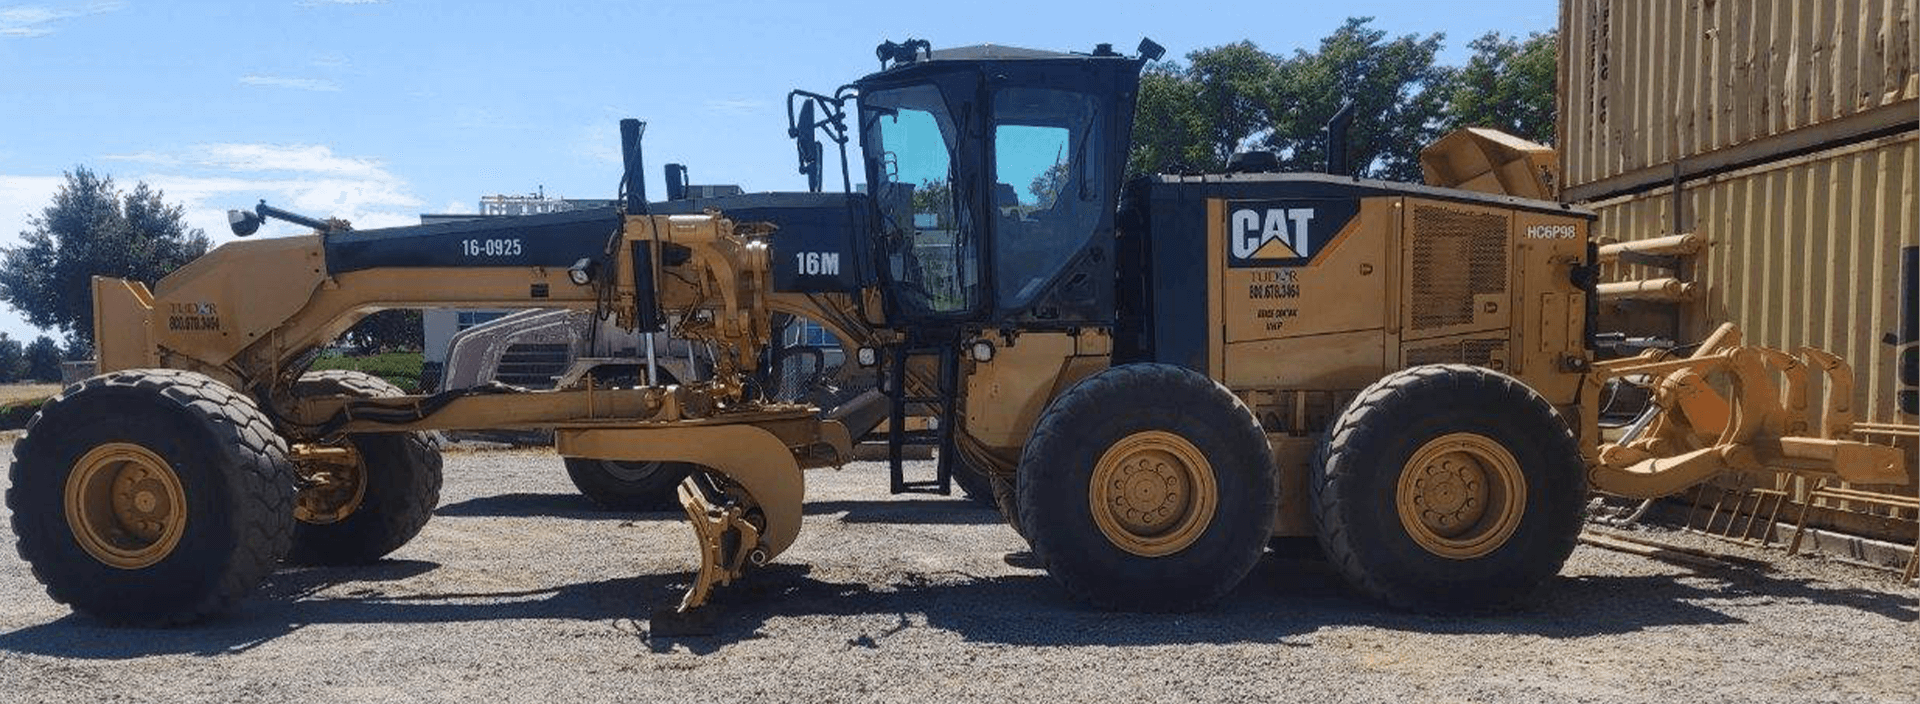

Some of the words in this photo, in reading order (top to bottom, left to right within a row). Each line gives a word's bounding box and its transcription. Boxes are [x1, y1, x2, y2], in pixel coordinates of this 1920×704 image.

[1232, 208, 1315, 259] CAT
[1527, 224, 1576, 239] HC6P98
[462, 239, 522, 256] 16-0925
[796, 251, 840, 275] 16M
